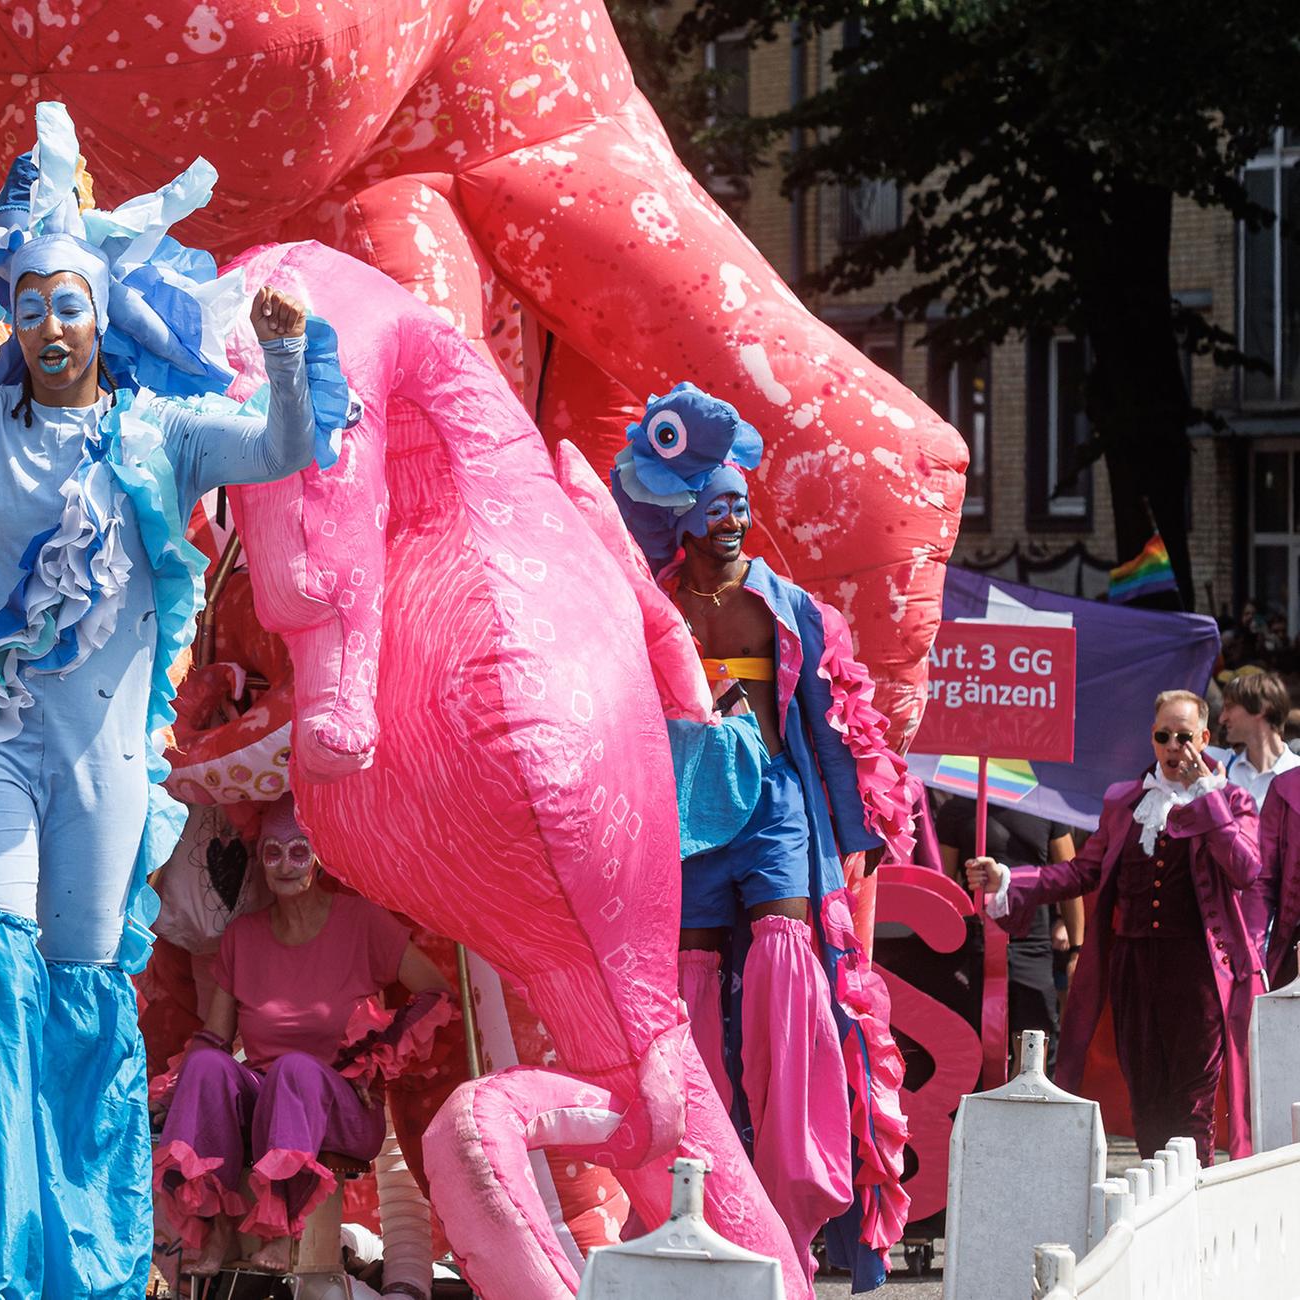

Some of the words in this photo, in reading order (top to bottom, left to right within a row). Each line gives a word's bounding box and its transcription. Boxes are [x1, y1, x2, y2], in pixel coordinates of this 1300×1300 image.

[929, 643, 973, 670] Art.
[979, 643, 997, 671] 3
[1009, 646, 1053, 676] GG
